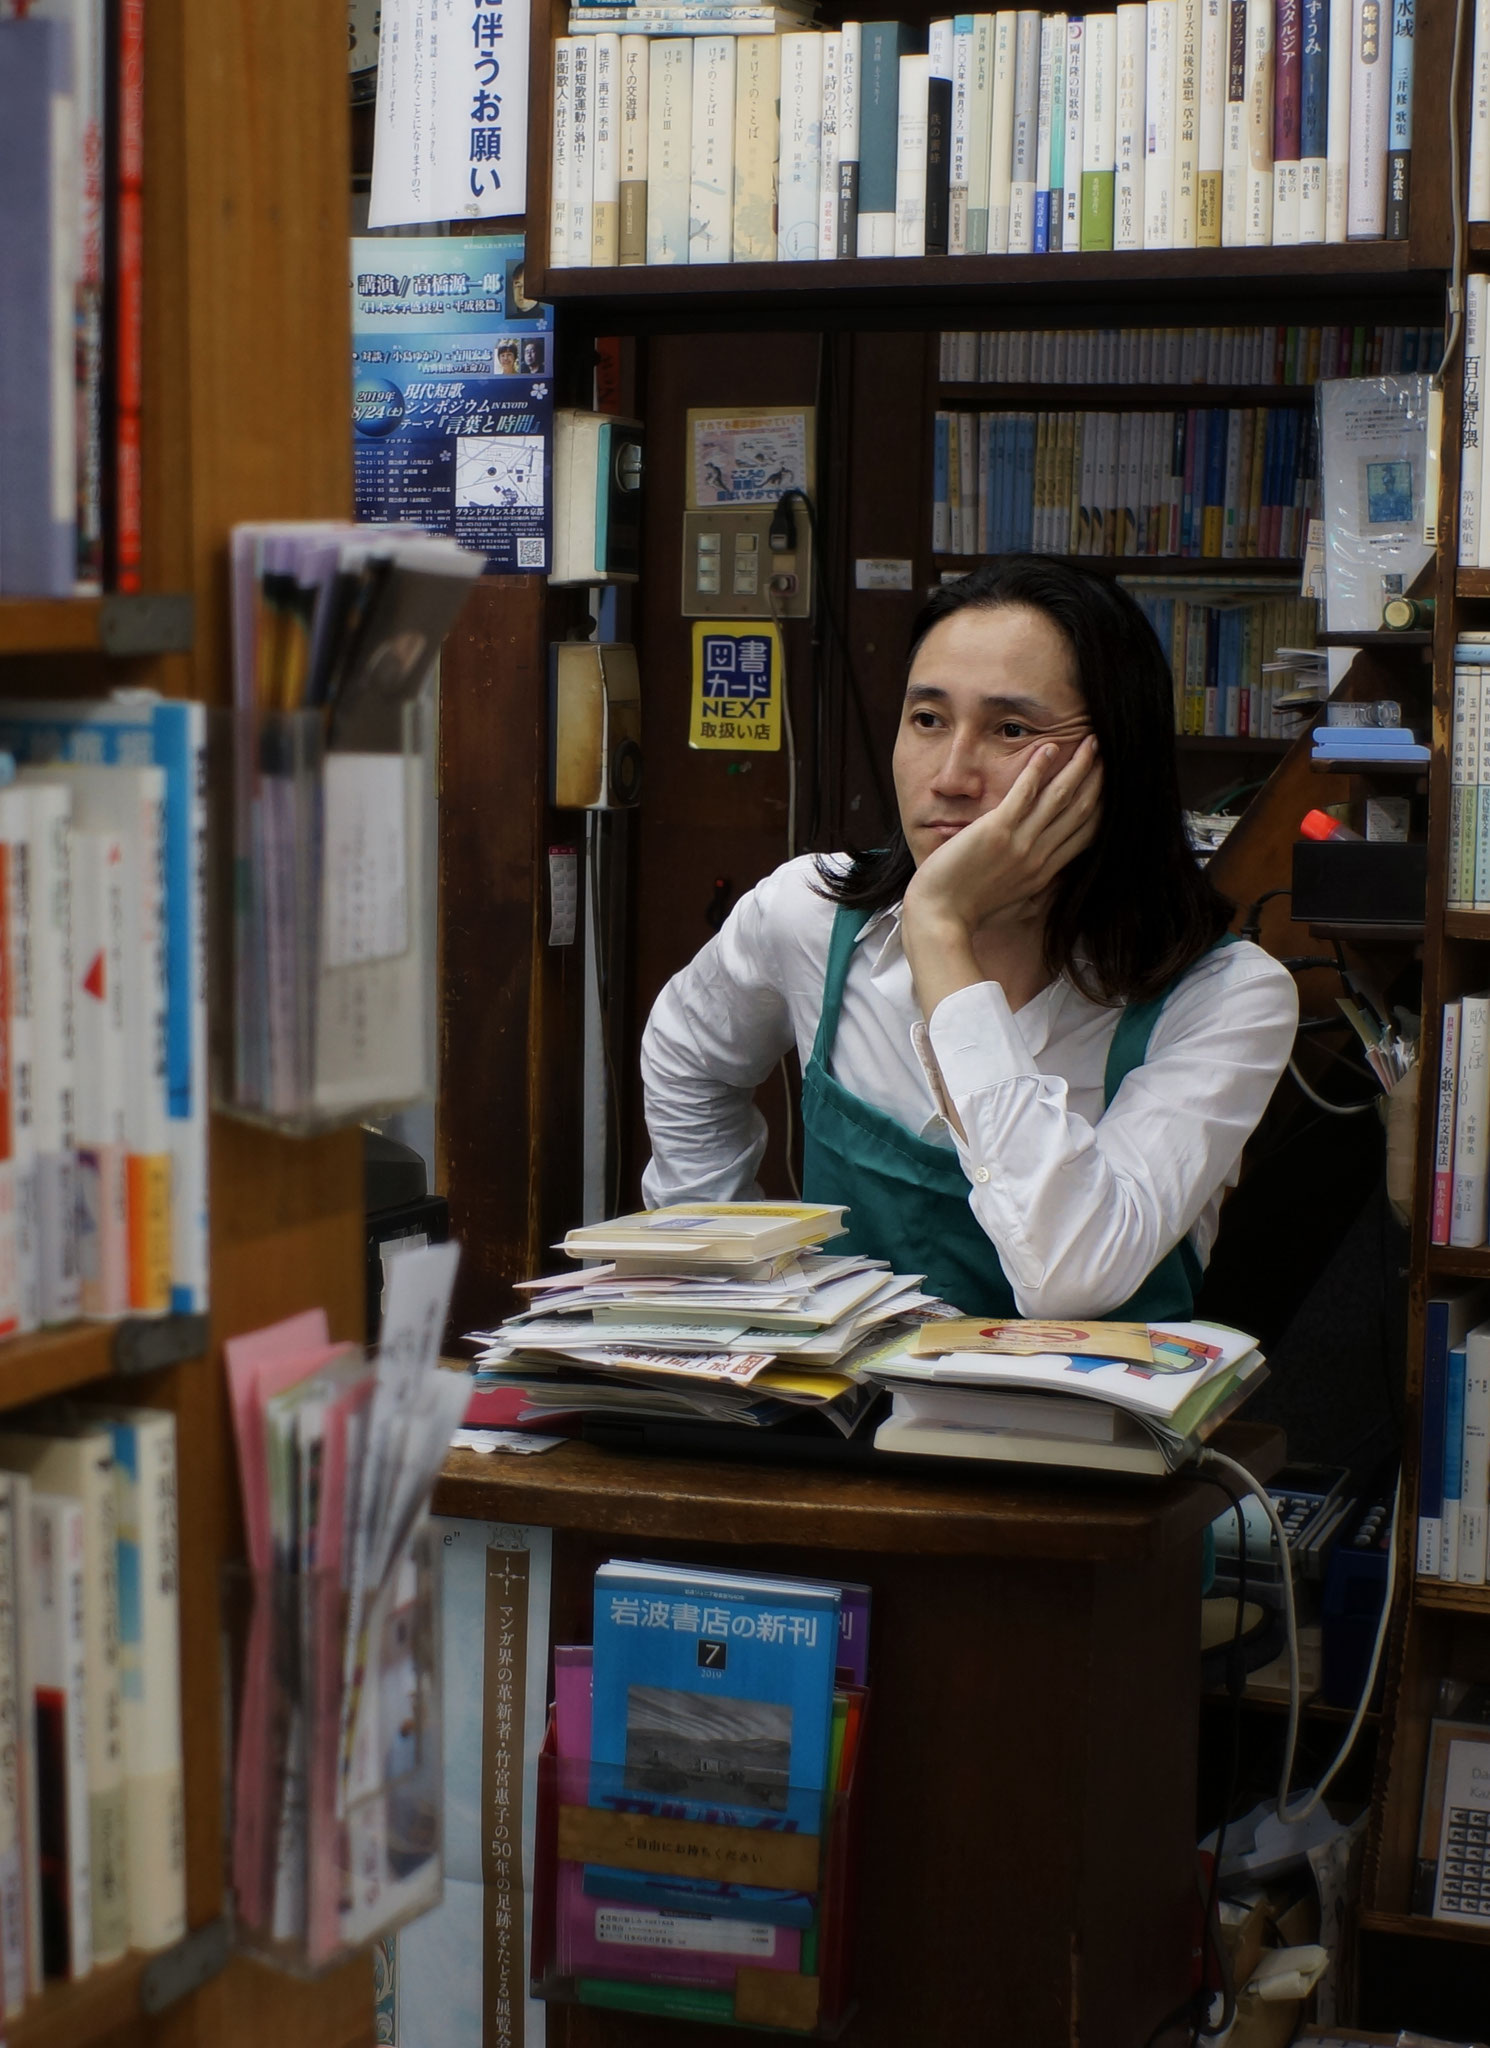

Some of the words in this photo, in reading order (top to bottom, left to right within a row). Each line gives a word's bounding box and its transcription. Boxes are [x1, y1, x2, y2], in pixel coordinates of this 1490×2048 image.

[598, 48, 610, 142] 挫折と再生の季節
[626, 52, 638, 121] ぼくの交遊録
[842, 53, 854, 129] 暮れてゆくバッハ
[556, 49, 570, 166] 前衛歌人と呼ばれるまで
[574, 47, 587, 163] 前衛短歌運動の渦中で
[823, 76, 837, 136] 詩の点滅
[357, 391, 396, 402] 2019年
[404, 383, 465, 399] 現代短歌
[405, 400, 491, 415] シンポジウム
[501, 402, 528, 410] KYOTO
[401, 419, 434, 430] テーマ
[437, 415, 541, 434] 『言葉と時間』
[456, 508, 545, 516] グランドプリンスホテル京都
[1462, 490, 1475, 546] 第九歌集
[707, 641, 767, 673] 図書
[707, 674, 768, 700] カード
[702, 700, 771, 719] NEXT
[700, 722, 771, 741] 取扱い店
[1469, 1008, 1487, 1070] 歌ことば
[1438, 1066, 1453, 1166] 名歌で学ぶ文語文法
[610, 1597, 817, 1648] 岩波書店の新刊
[705, 1644, 719, 1666] 7
[701, 1669, 722, 1679] 2019
[624, 1836, 764, 1864] ご自由にお持ちください
